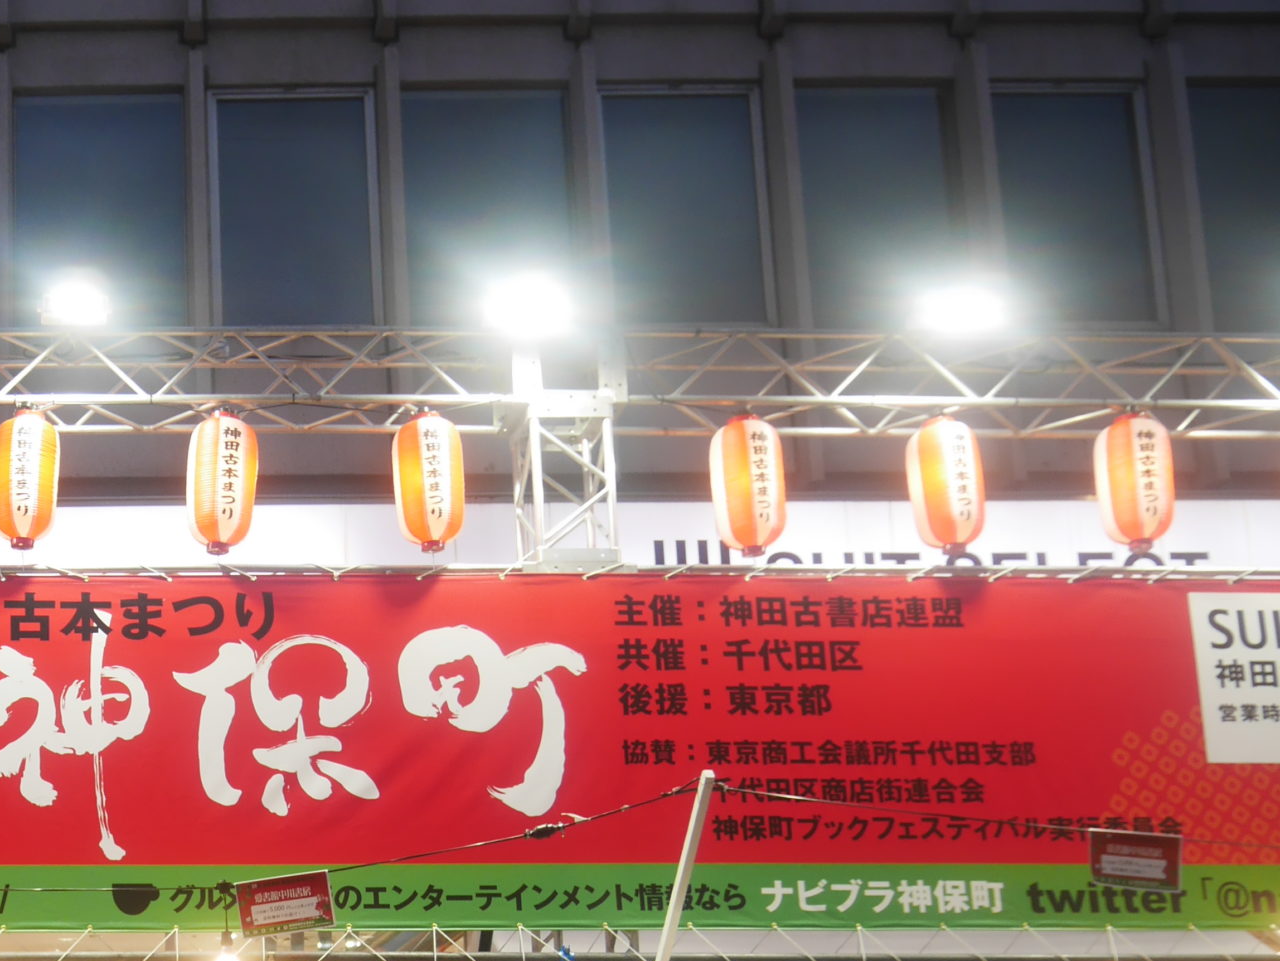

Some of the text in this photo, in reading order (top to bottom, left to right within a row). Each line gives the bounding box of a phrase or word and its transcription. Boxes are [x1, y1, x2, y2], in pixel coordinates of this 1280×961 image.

[221, 426, 242, 520] 神田古本まつり
[422, 427, 448, 521] 神田古本まつり
[750, 431, 771, 523] 神田古本まつり
[1137, 429, 1159, 517] 神田古本まつり
[714, 777, 985, 805] 千代田区商店街連合会
[761, 879, 1005, 914] ナビブラ神保町
[1027, 882, 1188, 914] twitter
